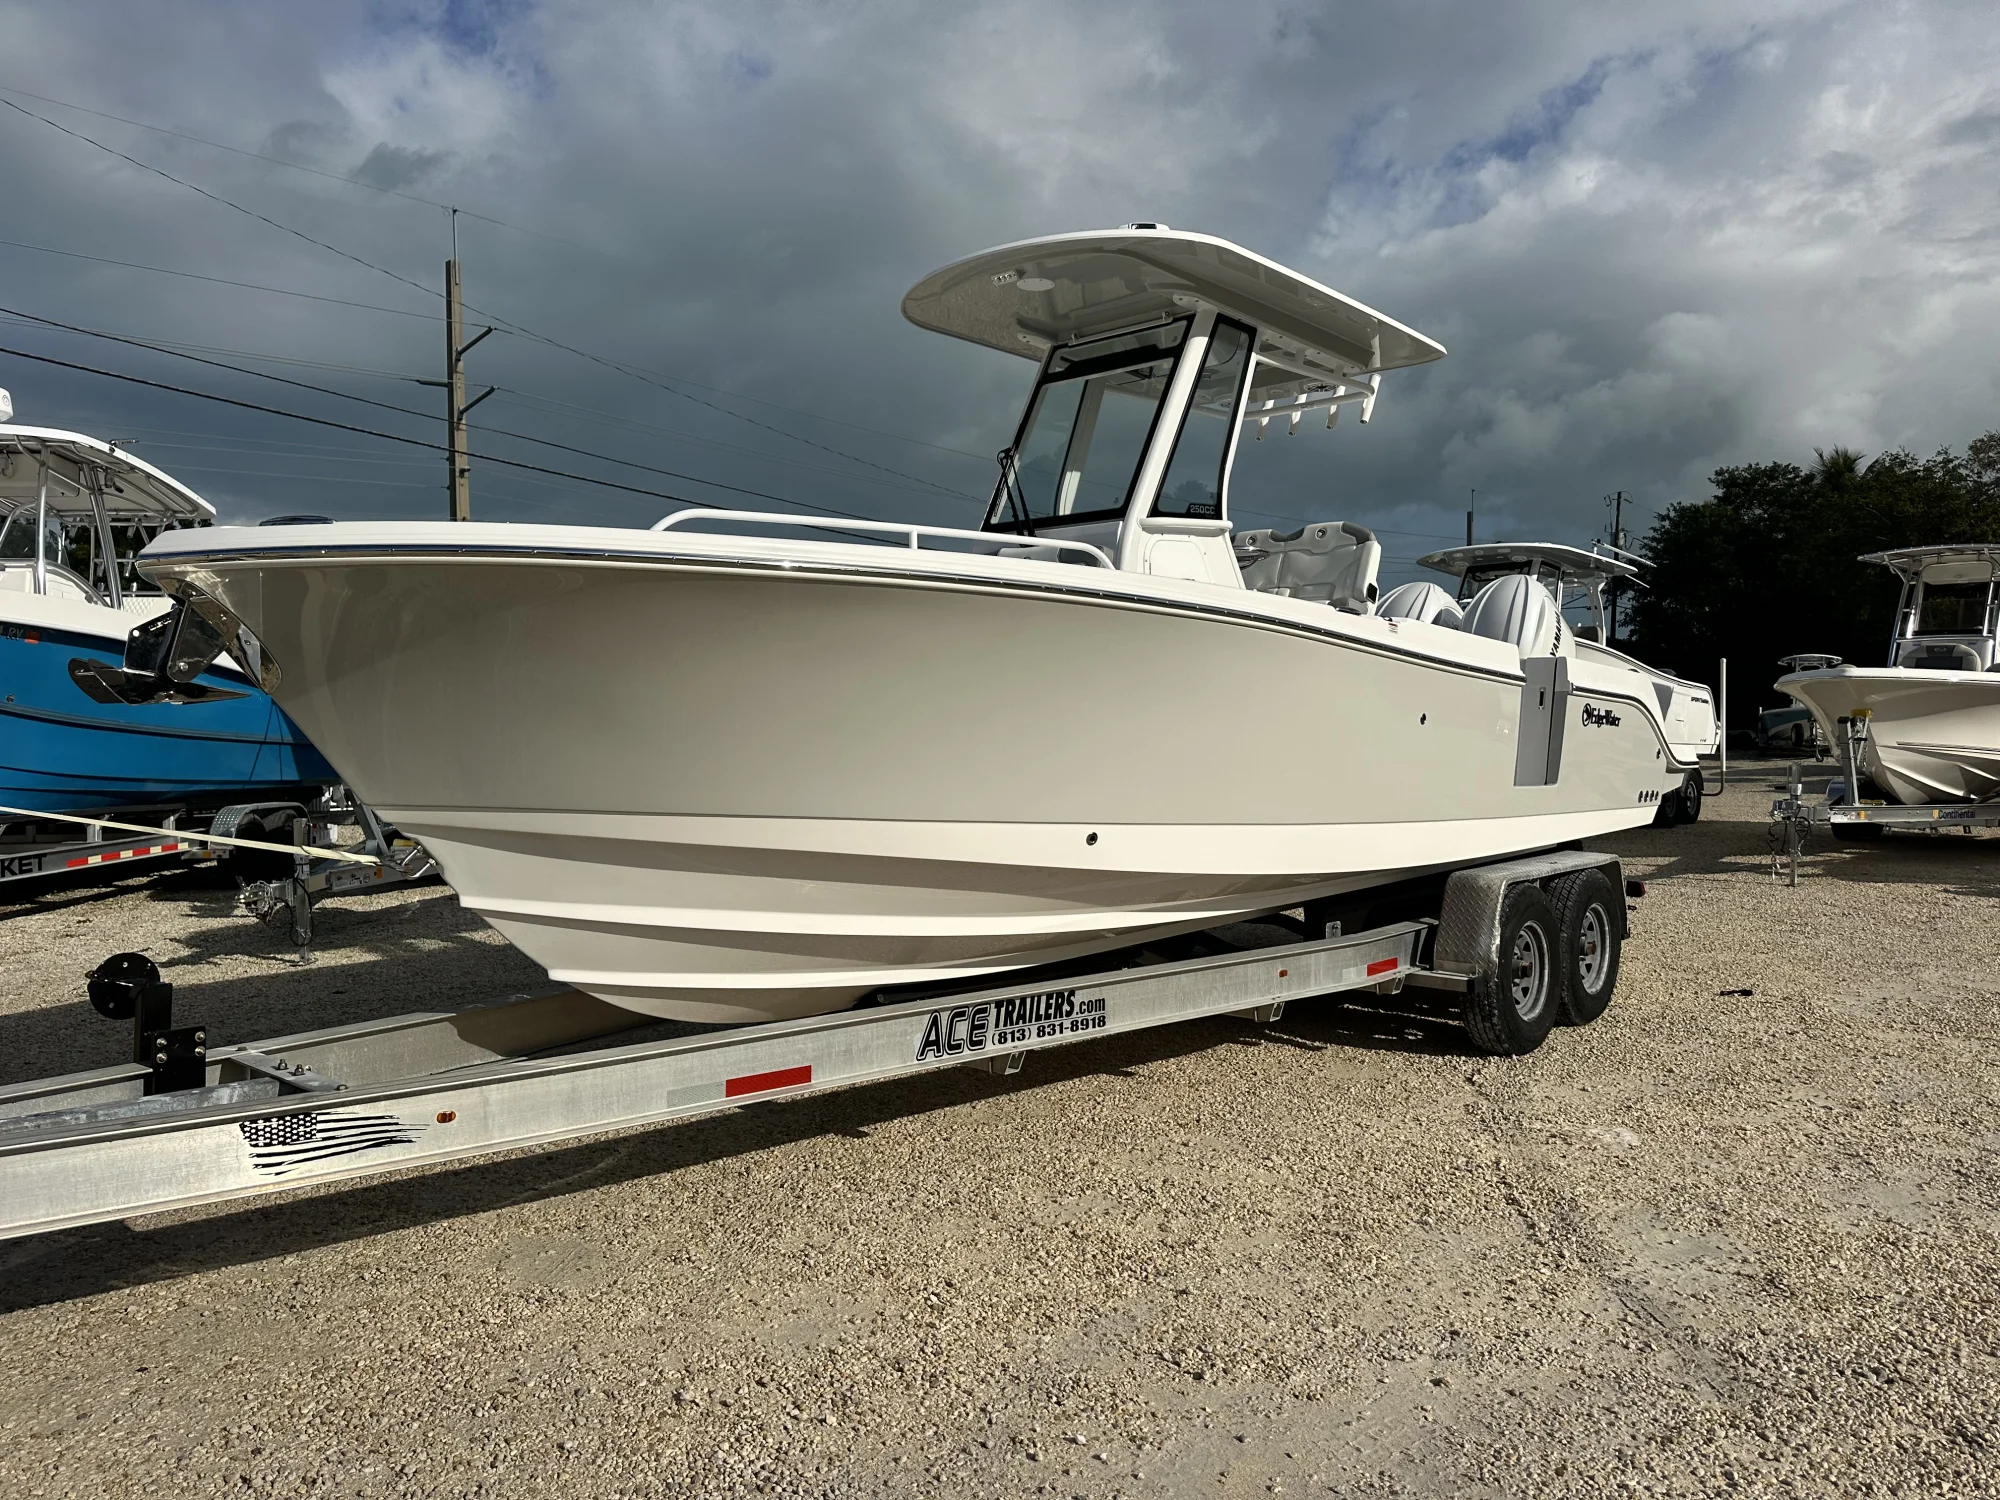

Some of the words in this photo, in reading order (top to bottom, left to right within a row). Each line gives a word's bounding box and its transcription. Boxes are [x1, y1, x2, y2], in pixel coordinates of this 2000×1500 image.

[1190, 504, 1216, 514] 250CC
[1550, 610, 1561, 657] YAMAHA
[1938, 809, 1976, 819] Continental
[916, 1003, 991, 1061] ACE
[991, 1027, 1031, 1046] (813)
[1036, 1015, 1106, 1038] 831-8918
